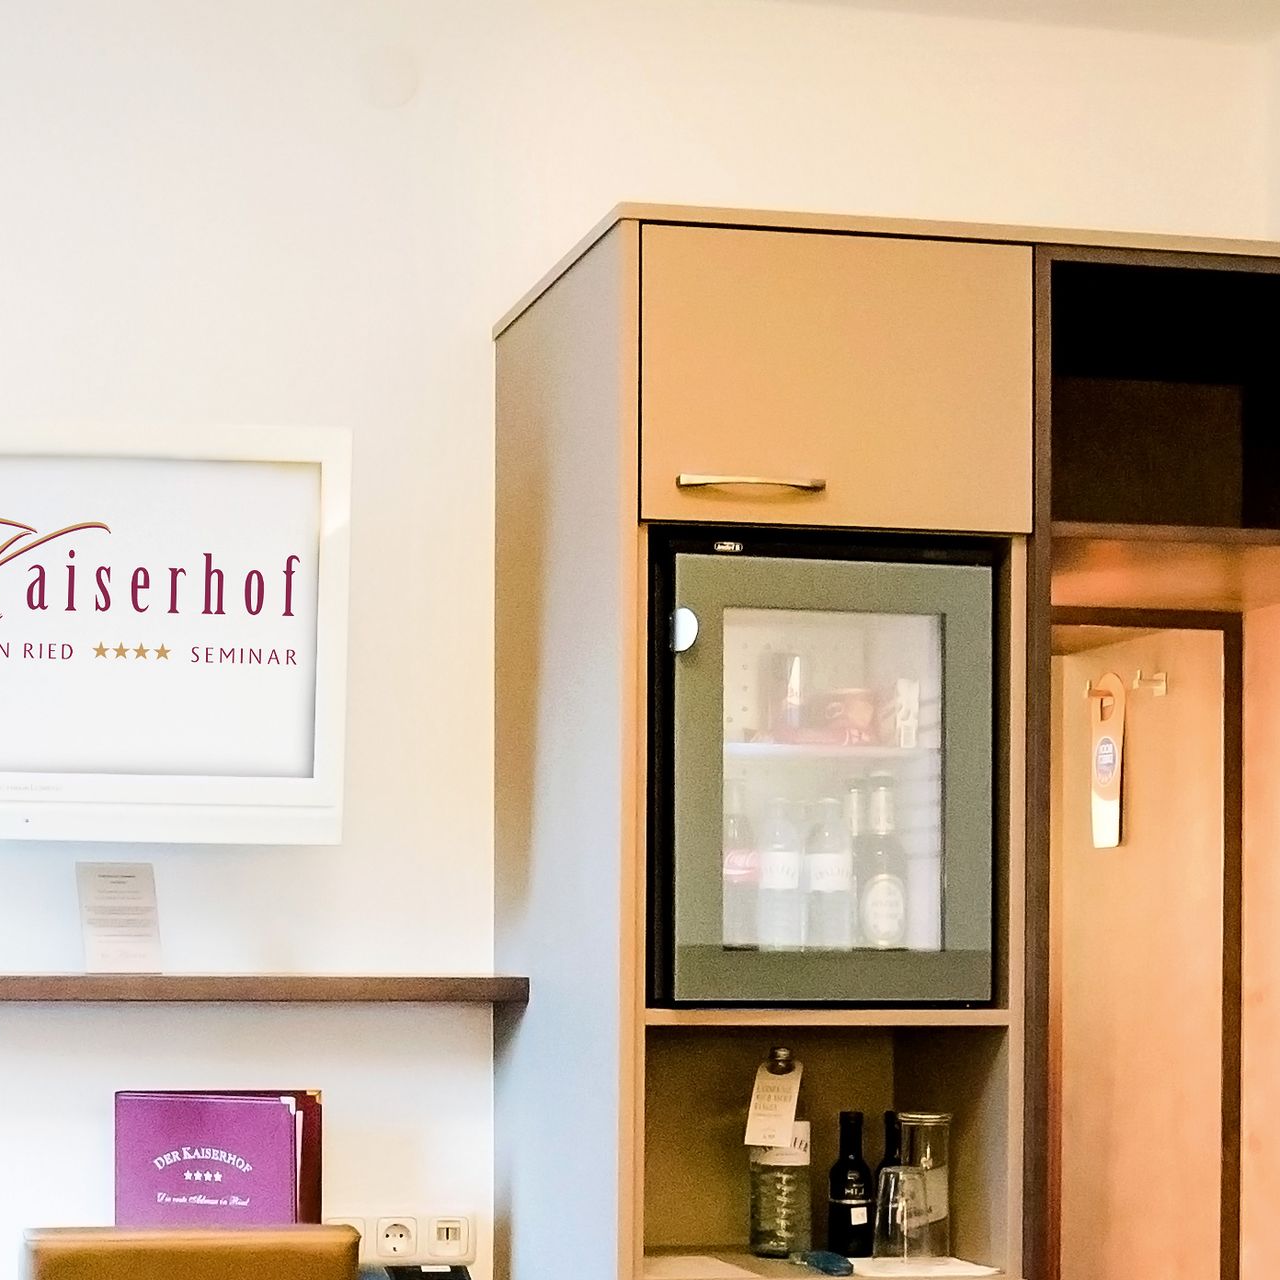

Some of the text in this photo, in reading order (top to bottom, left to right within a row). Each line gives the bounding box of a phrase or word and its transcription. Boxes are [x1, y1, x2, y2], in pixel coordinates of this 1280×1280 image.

[23, 642, 74, 660] RIED
[191, 646, 299, 666] SEMINAR
[153, 1146, 253, 1174] DER KAISERHOF
